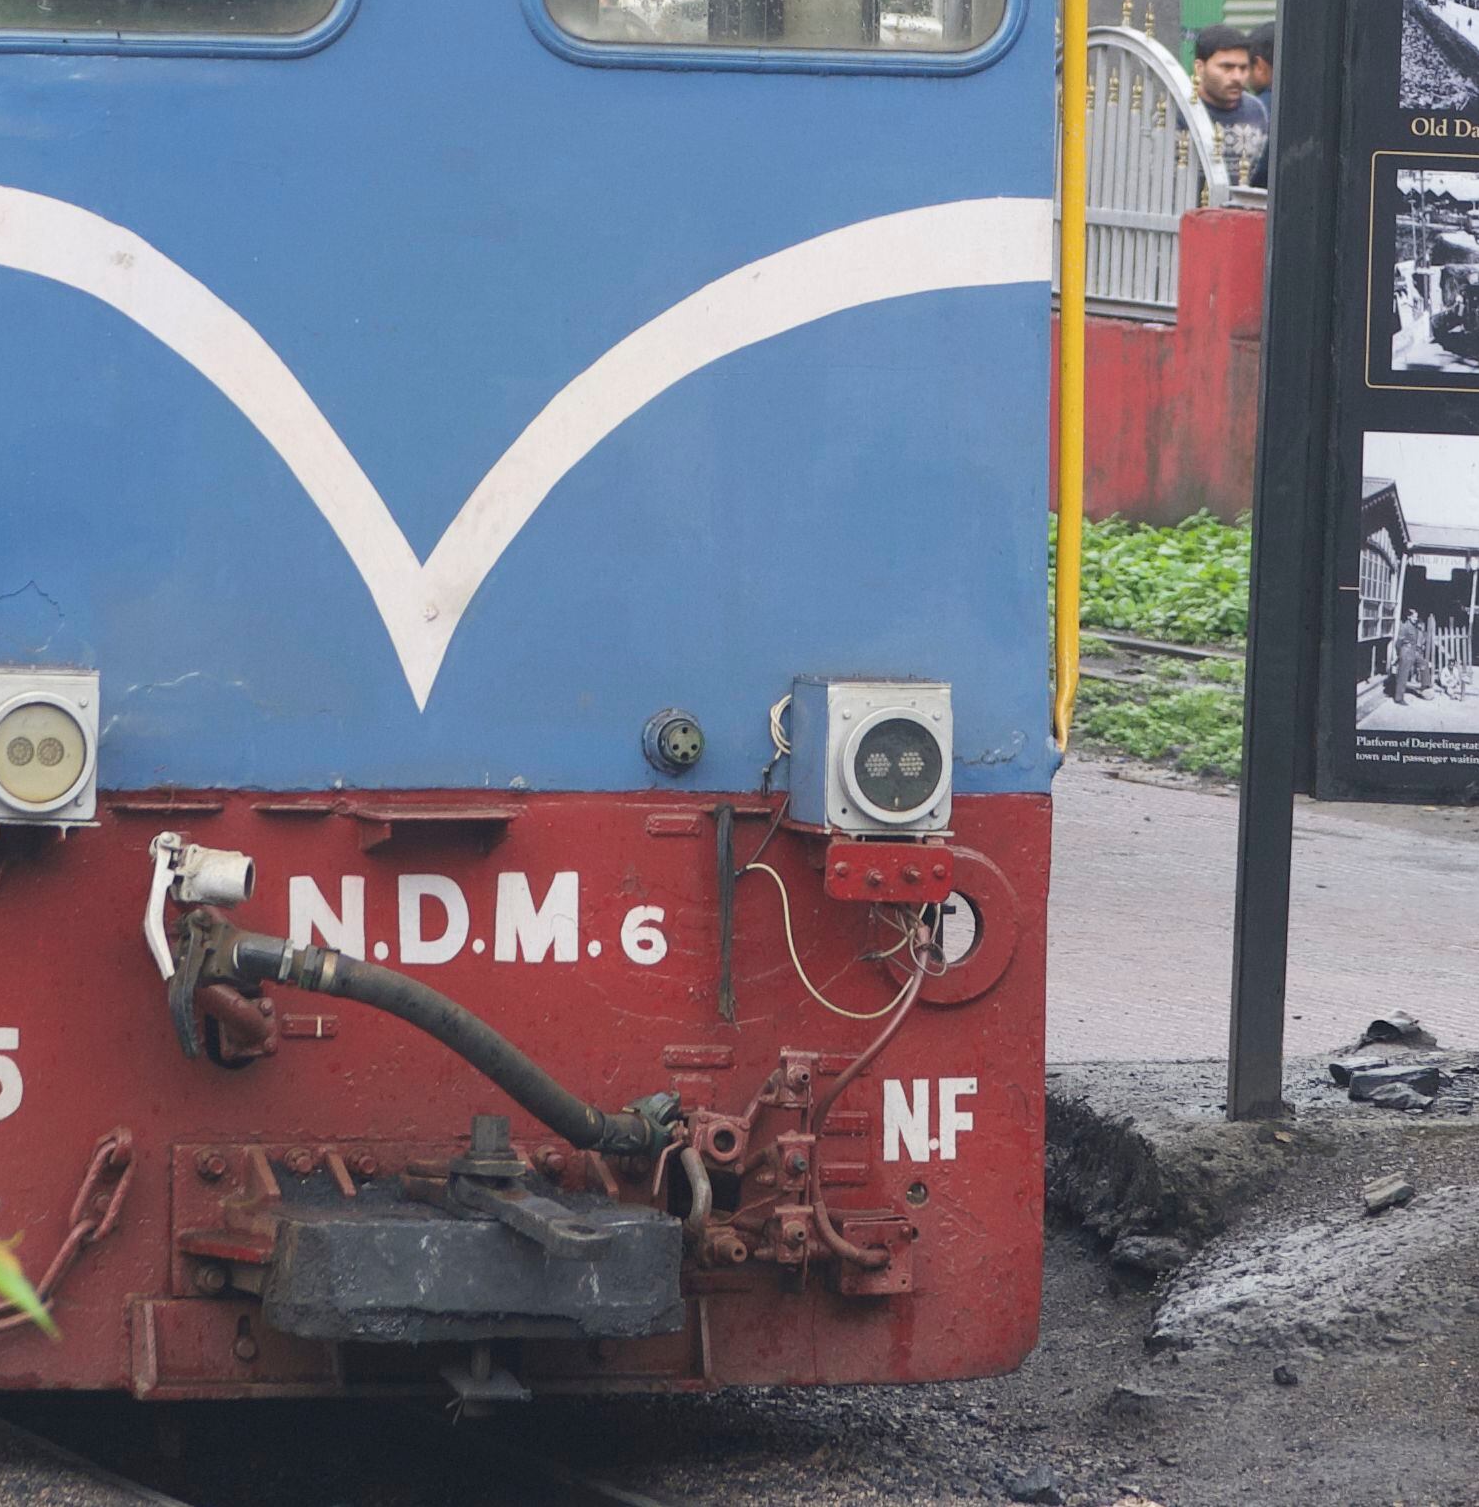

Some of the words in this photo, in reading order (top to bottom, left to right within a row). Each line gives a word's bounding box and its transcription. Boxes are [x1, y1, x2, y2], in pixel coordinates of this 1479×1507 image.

[1411, 117, 1448, 138] Old
[1356, 735, 1399, 748] Platform
[1400, 738, 1410, 748] of
[1411, 737, 1460, 751] Darjeeling
[1355, 752, 1380, 761] town
[1381, 751, 1400, 761] and
[1402, 754, 1448, 764] passenger
[883, 1077, 978, 1162] N.F
